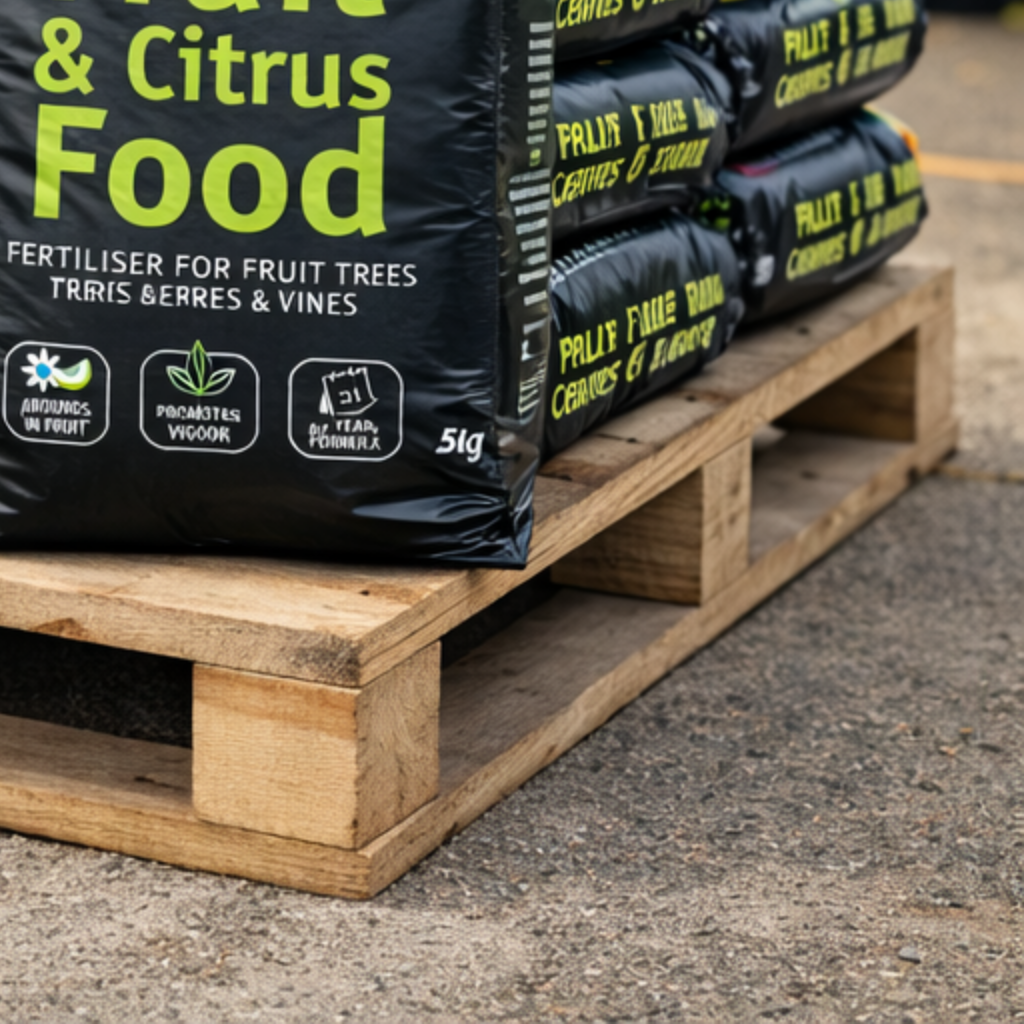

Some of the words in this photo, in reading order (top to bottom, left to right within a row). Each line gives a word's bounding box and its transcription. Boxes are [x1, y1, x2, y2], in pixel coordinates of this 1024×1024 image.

[33, 16, 95, 96] &
[126, 24, 392, 112] Citrus
[33, 103, 387, 238] Food
[6, 240, 164, 277] FERTILISER
[175, 254, 232, 280] FOR
[242, 257, 326, 285] FRUIT
[335, 261, 418, 288] TREES
[251, 288, 271, 313] &
[278, 290, 357, 317] VINES
